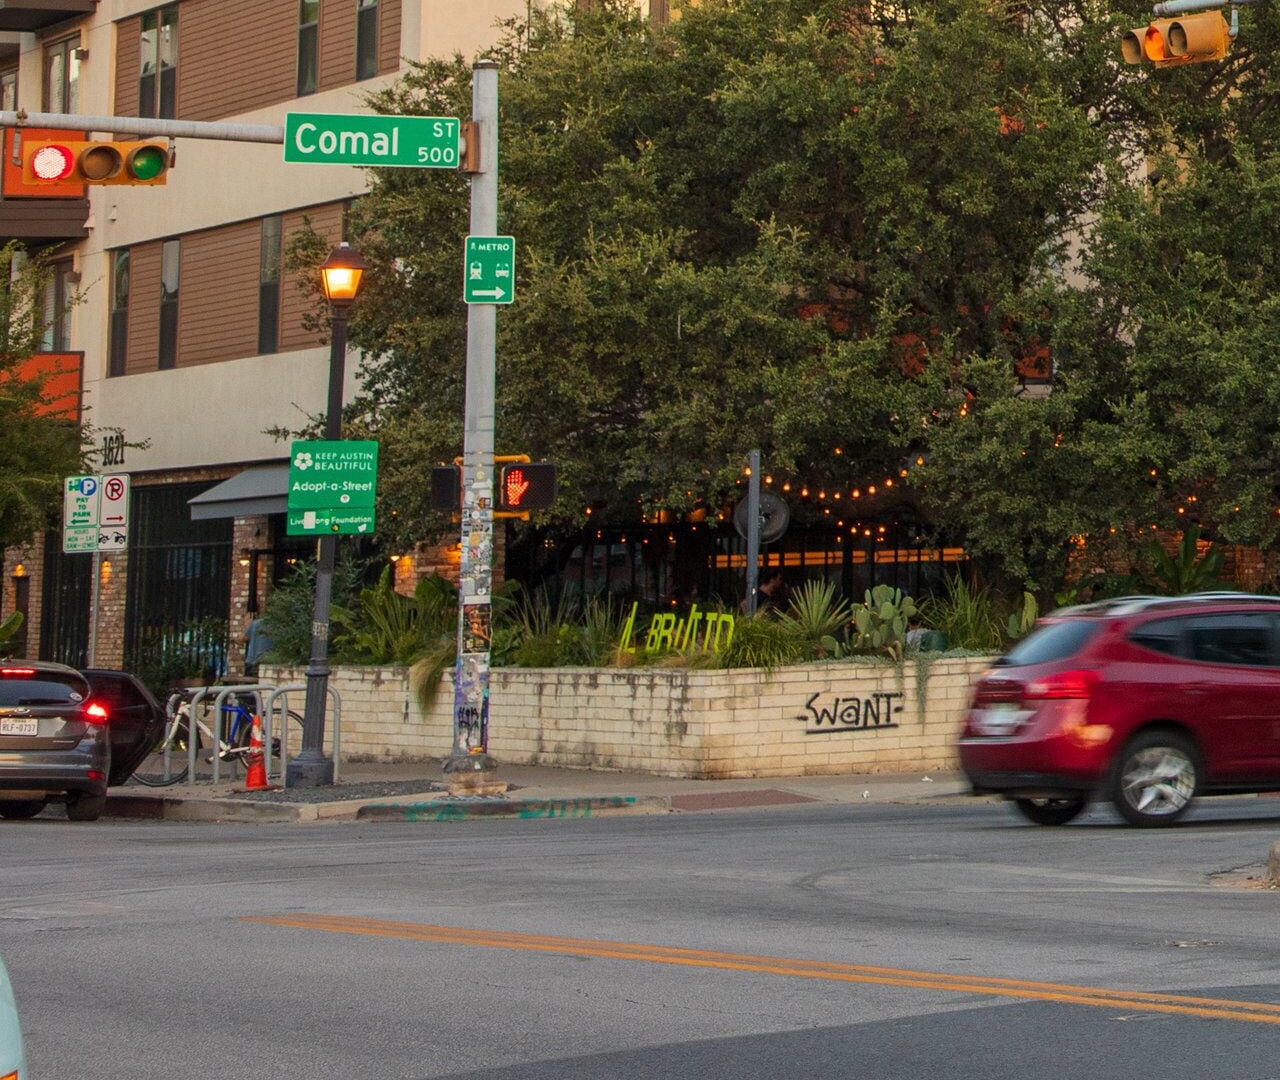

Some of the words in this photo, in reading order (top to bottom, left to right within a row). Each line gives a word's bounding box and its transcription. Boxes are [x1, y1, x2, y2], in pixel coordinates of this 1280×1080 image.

[295, 122, 399, 156] Comal
[432, 122, 455, 138] ST
[417, 147, 455, 163] 500
[478, 243, 510, 252] METRO
[102, 434, 125, 466] 1621
[314, 462, 373, 471] BEAUTIFUL
[292, 481, 372, 493] Adopt-a-Street
[331, 516, 373, 524] Foundation
